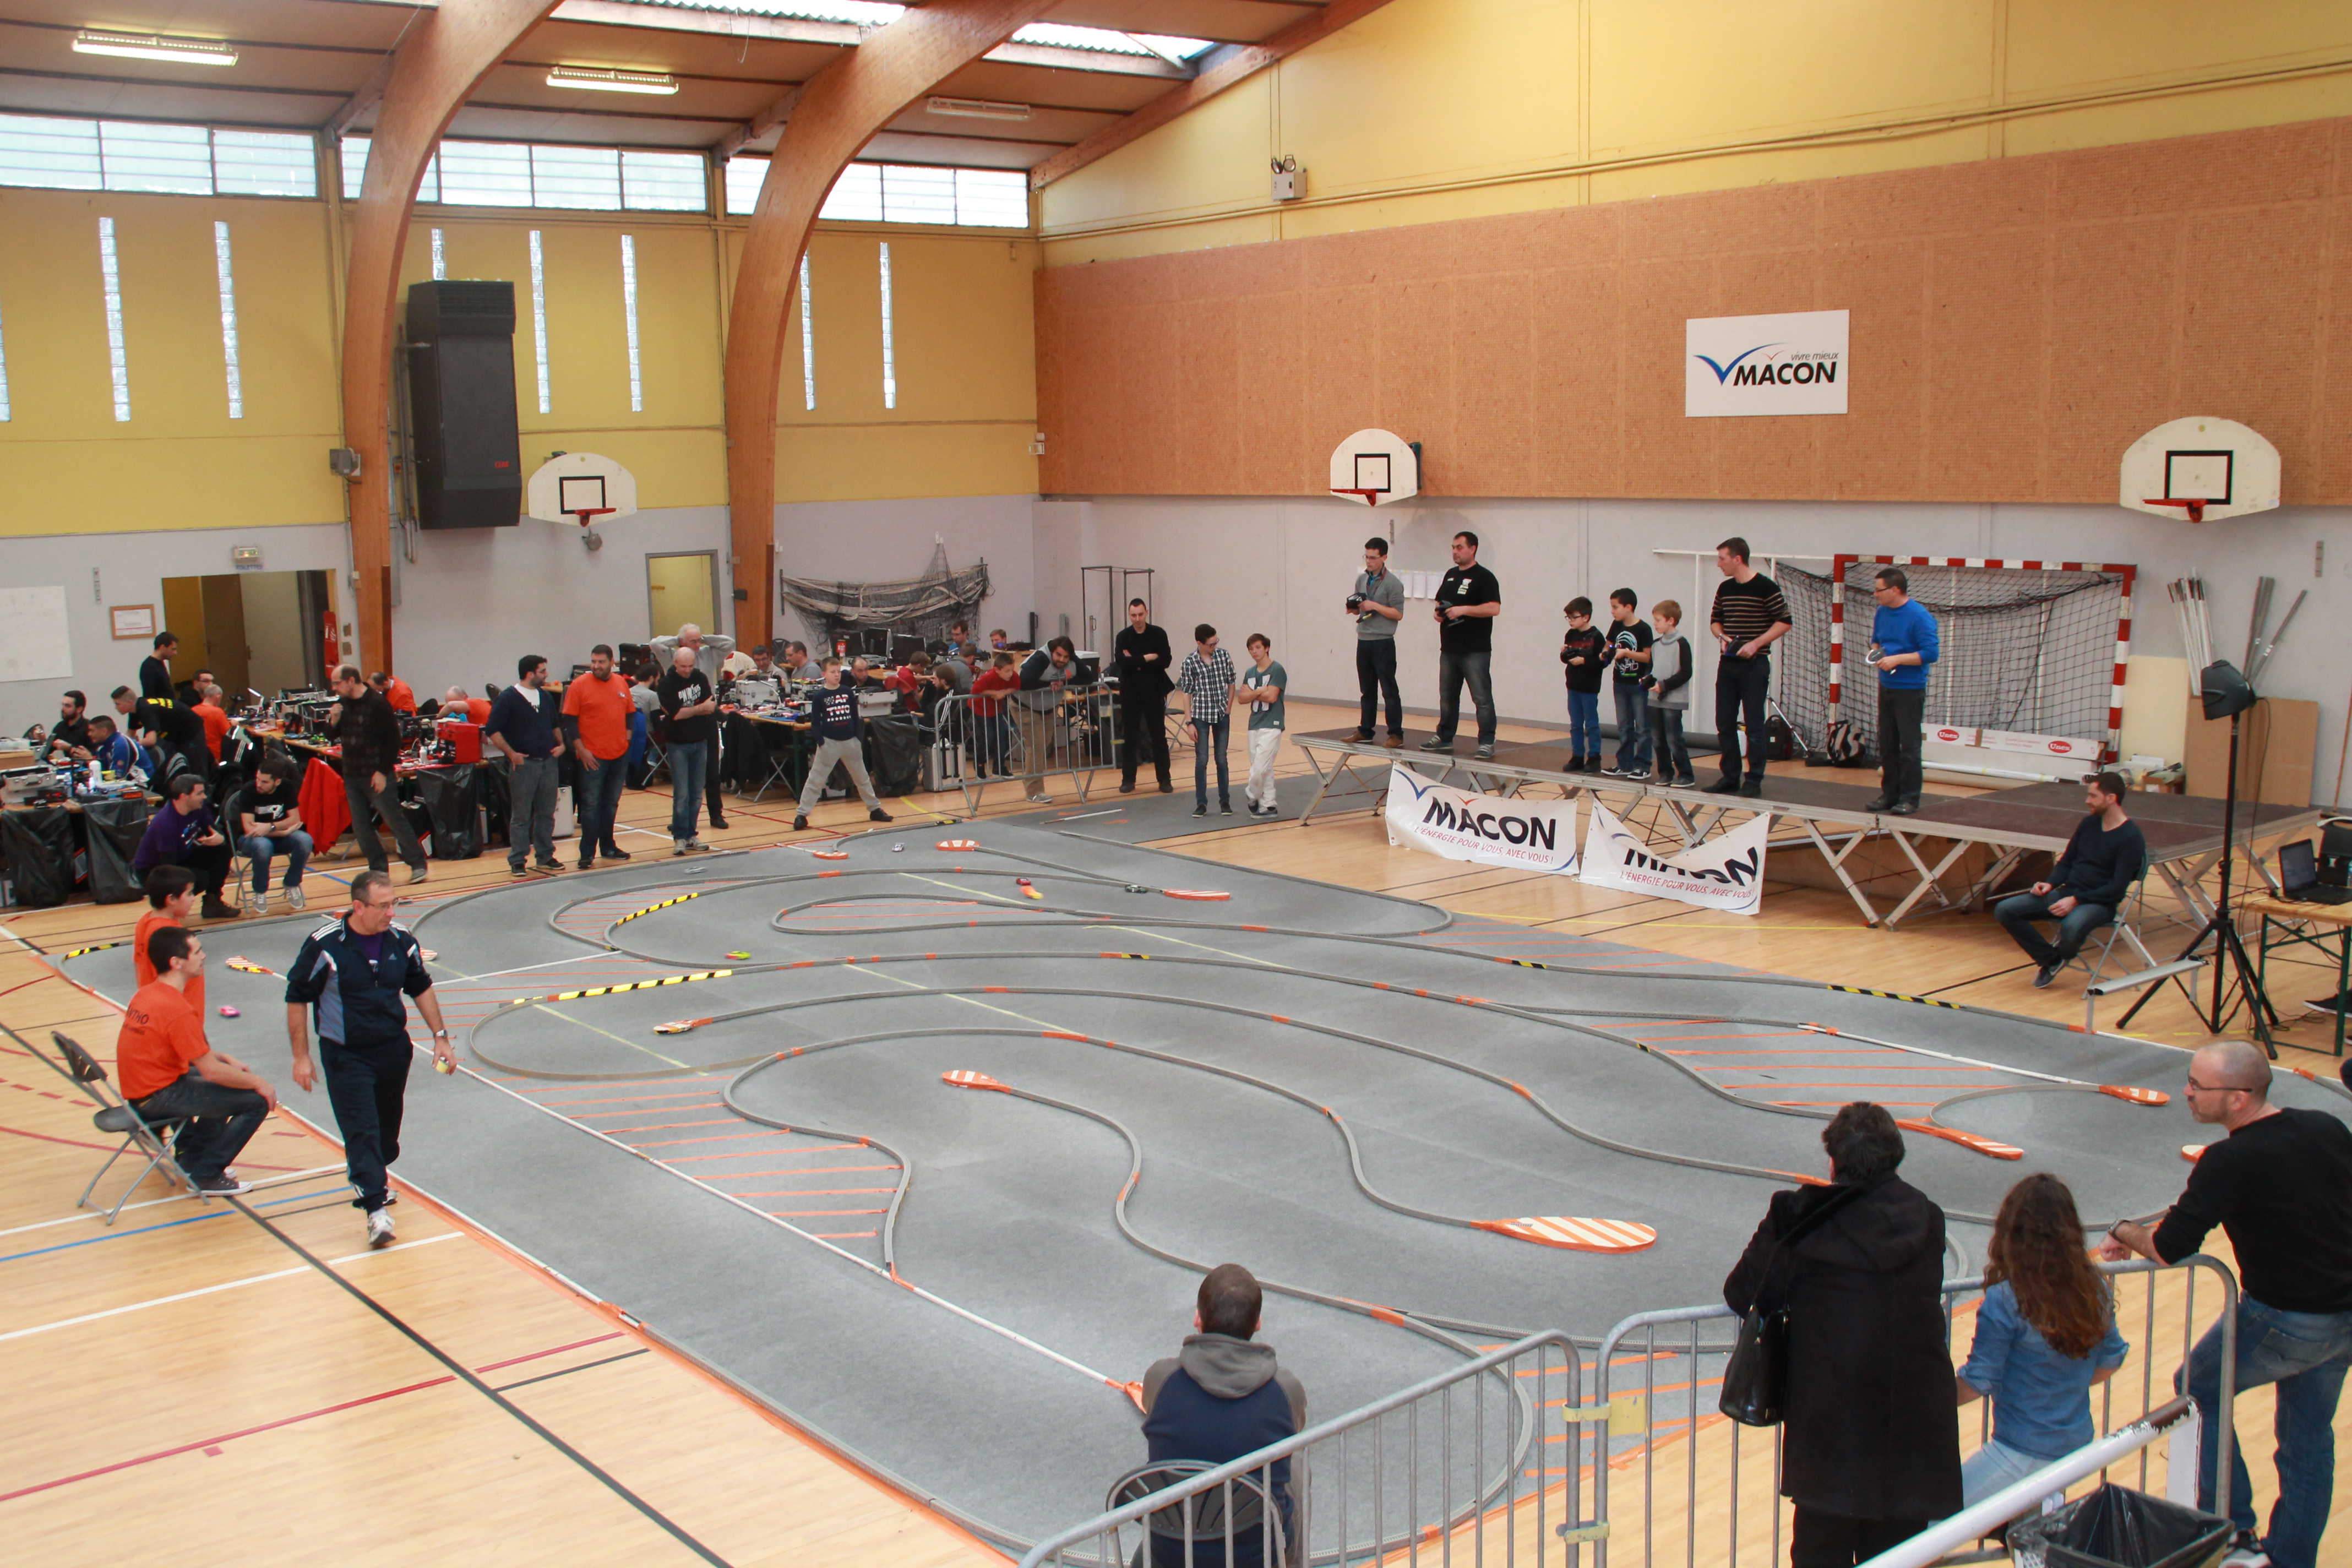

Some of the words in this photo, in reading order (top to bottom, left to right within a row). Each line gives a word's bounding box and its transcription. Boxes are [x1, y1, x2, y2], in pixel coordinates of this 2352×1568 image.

[1791, 351, 1810, 361] vivre
[1812, 351, 1838, 360] mieux
[1733, 361, 1837, 386] MACON
[1423, 796, 1556, 850] MACON
[1457, 838, 1480, 850] POUR
[1482, 843, 1504, 855] VOUS,
[1506, 848, 1527, 859] AVEC
[1662, 879, 1684, 890] POUR
[1709, 887, 1733, 897] AVEC
